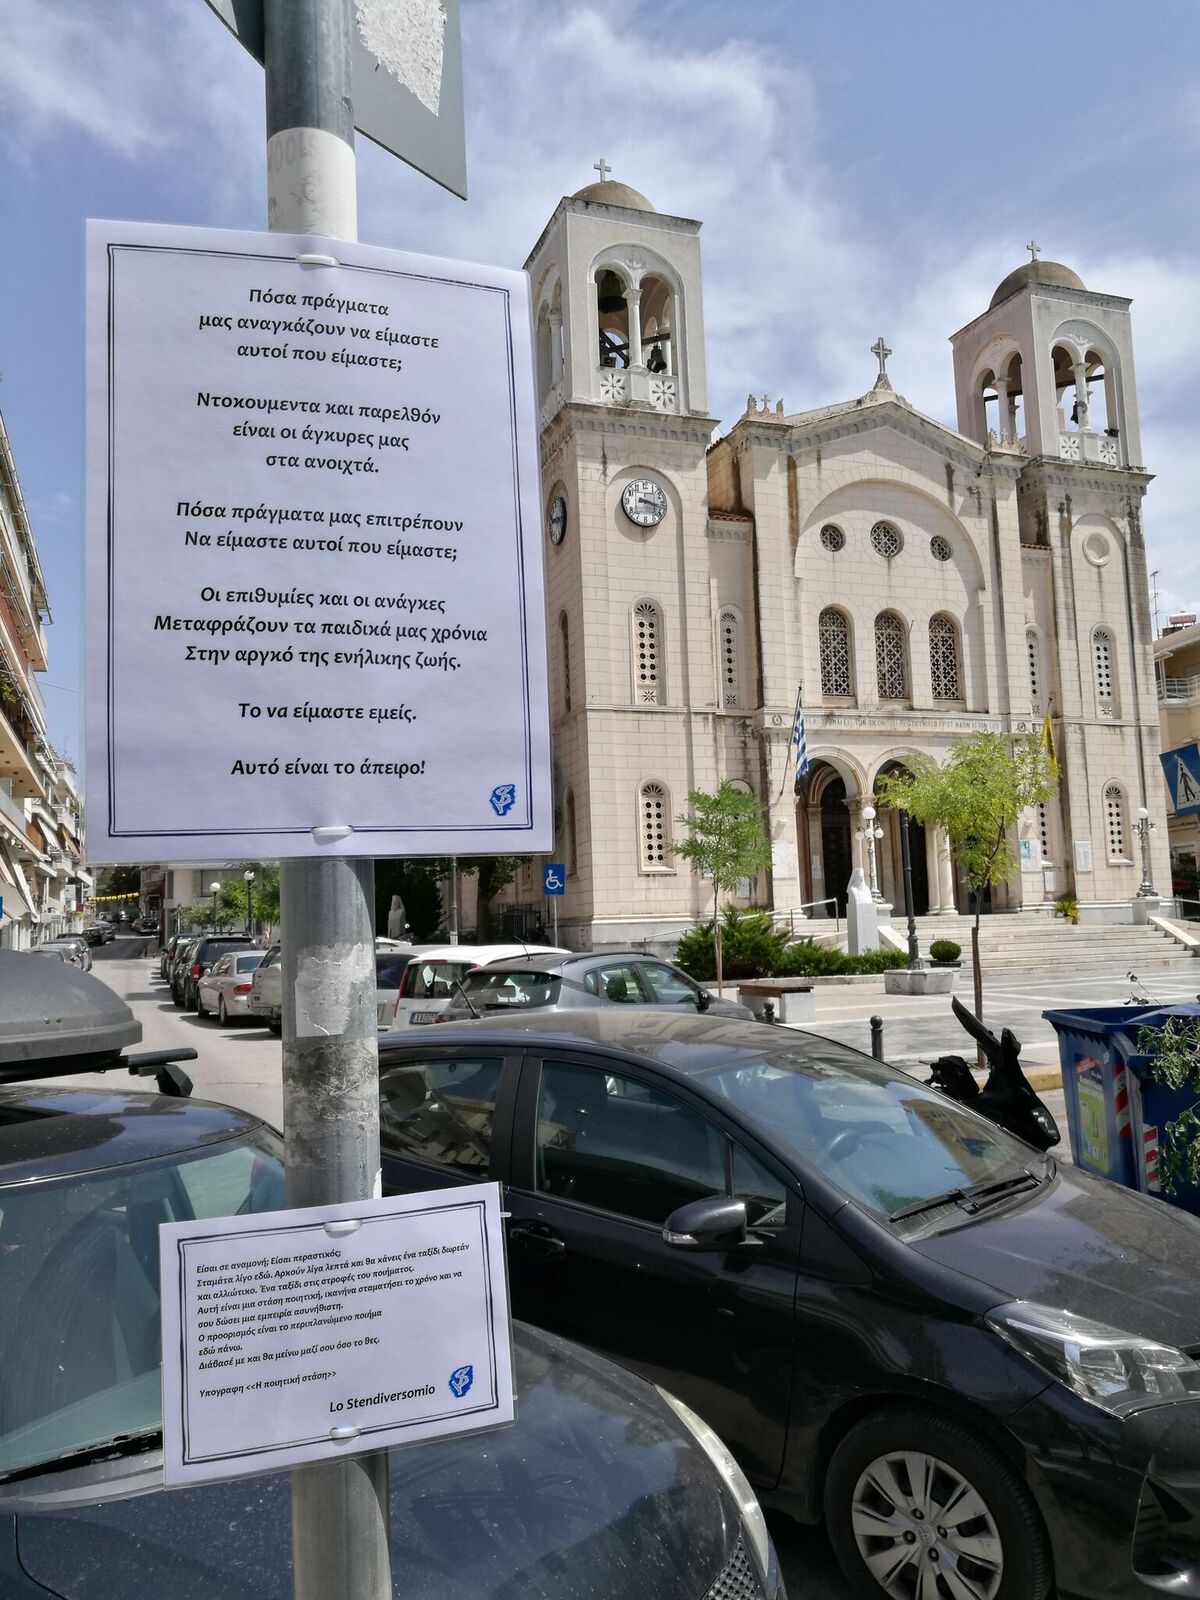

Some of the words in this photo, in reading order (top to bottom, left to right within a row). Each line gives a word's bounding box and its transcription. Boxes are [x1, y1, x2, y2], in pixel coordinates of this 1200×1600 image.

[249, 288, 297, 305] Πόσα
[301, 293, 389, 316] πράγματα
[199, 315, 233, 331] μας
[237, 317, 346, 337] αναγκάζουν
[349, 327, 371, 340] να
[375, 327, 439, 348] είμαστε
[237, 343, 289, 359] αυτοί
[292, 349, 327, 362] που
[331, 348, 402, 373] είμαστε;
[197, 392, 321, 414] Ντοκουμεντα
[325, 403, 354, 416] και
[358, 406, 441, 424] παρελθόν
[232, 420, 276, 438] είναι
[280, 427, 297, 439] οι
[301, 424, 374, 448] άγκυρες
[378, 435, 410, 452] μας
[266, 455, 300, 468] στα
[304, 456, 379, 476] ανοιχτά.
[176, 500, 227, 518] Πόσα
[231, 503, 325, 525] πράγματα
[329, 512, 362, 528] μας
[366, 513, 463, 532] επιτρέπουν
[185, 531, 211, 547] Να
[216, 530, 288, 552] είμαστε
[292, 535, 344, 552] αυτοί
[347, 541, 382, 554] που
[386, 539, 457, 563] είμαστε;
[200, 587, 221, 602] Οι
[226, 587, 315, 608] επιθυμίες
[319, 594, 349, 606] και
[353, 595, 370, 607] οι
[374, 593, 446, 615] ανάγκες
[154, 615, 289, 636] Μεταφράζουν
[293, 622, 316, 634] τα
[320, 619, 392, 637] παιδικά
[395, 626, 427, 642] μας
[430, 624, 488, 644] χρόνια
[184, 645, 230, 666] Στην
[235, 645, 294, 666] αργκό
[298, 651, 330, 667] της
[334, 648, 411, 670] ενήλικης
[415, 651, 461, 672] ζωής.
[238, 703, 262, 718] Το
[266, 706, 289, 718] να
[293, 701, 364, 723] είμαστε
[368, 703, 417, 724] εμείς.
[230, 757, 280, 775] Αυτό
[284, 757, 329, 775] είναι
[333, 763, 355, 775] το
[360, 757, 426, 781] άπειρο!
[197, 1265, 217, 1274] Είσαι
[230, 1257, 269, 1270] αναμονή;
[271, 1256, 291, 1265] Είσαι
[293, 1249, 342, 1263] περαστικός;
[197, 1276, 234, 1287] Σταμάτα
[235, 1275, 253, 1283] λίγο
[254, 1271, 273, 1280] εδώ.
[275, 1267, 305, 1278] Αρκούν
[306, 1264, 324, 1274] λίγα
[325, 1261, 349, 1271] λεπτά
[351, 1259, 364, 1267] και
[365, 1257, 376, 1265] θα
[377, 1254, 402, 1263] κάνεις
[403, 1251, 416, 1260] ένα
[418, 1246, 440, 1257] ταξίδι
[441, 1243, 470, 1254] δωρεάν
[197, 1293, 211, 1301] και
[213, 1287, 258, 1299] αλλιώτικο.
[260, 1285, 276, 1293] Ένα
[278, 1281, 302, 1290] ταξίδι
[303, 1279, 320, 1287] στις
[321, 1273, 355, 1286] στροφές
[357, 1271, 371, 1279] του
[372, 1265, 415, 1278] ποιήματος.
[197, 1304, 219, 1314] Αυτή
[220, 1302, 240, 1312] είναι
[242, 1301, 256, 1310] μια
[257, 1297, 283, 1307] στάση
[285, 1292, 323, 1303] ποιητική,
[324, 1286, 357, 1297] ικανήνα
[358, 1279, 403, 1293] σταματήσει
[405, 1277, 414, 1285] το
[415, 1274, 438, 1286] χρόνο
[197, 1321, 214, 1329] σου
[215, 1317, 240, 1326] δώσει
[241, 1315, 256, 1324] μια
[257, 1310, 293, 1321] εμπειρία
[294, 1302, 343, 1316] ασυνήθιστη.
[198, 1334, 206, 1342] Ο
[207, 1327, 256, 1342] προορισμός
[257, 1325, 277, 1335] είναι
[279, 1323, 289, 1331] το
[290, 1313, 352, 1331] περιπλανώμενο
[354, 1309, 382, 1320] ποιήμα
[198, 1347, 216, 1356] εδώ
[217, 1345, 243, 1354] πάνω.
[199, 1358, 234, 1370] Διάβασέ
[235, 1357, 245, 1366] με
[247, 1354, 261, 1363] και
[262, 1352, 274, 1361] θα
[275, 1348, 299, 1361] μείνω
[300, 1344, 318, 1356] μαζί
[319, 1343, 335, 1352] σου
[337, 1340, 352, 1349] όσο
[364, 1336, 380, 1345] θες.
[200, 1385, 244, 1398] Υπογραφη
[246, 1381, 262, 1391] <<Η
[264, 1375, 301, 1388] ποιητική
[301, 1370, 337, 1382] στάση>>
[329, 1402, 344, 1413] Lo
[346, 1384, 436, 1410] Stendiversomio
